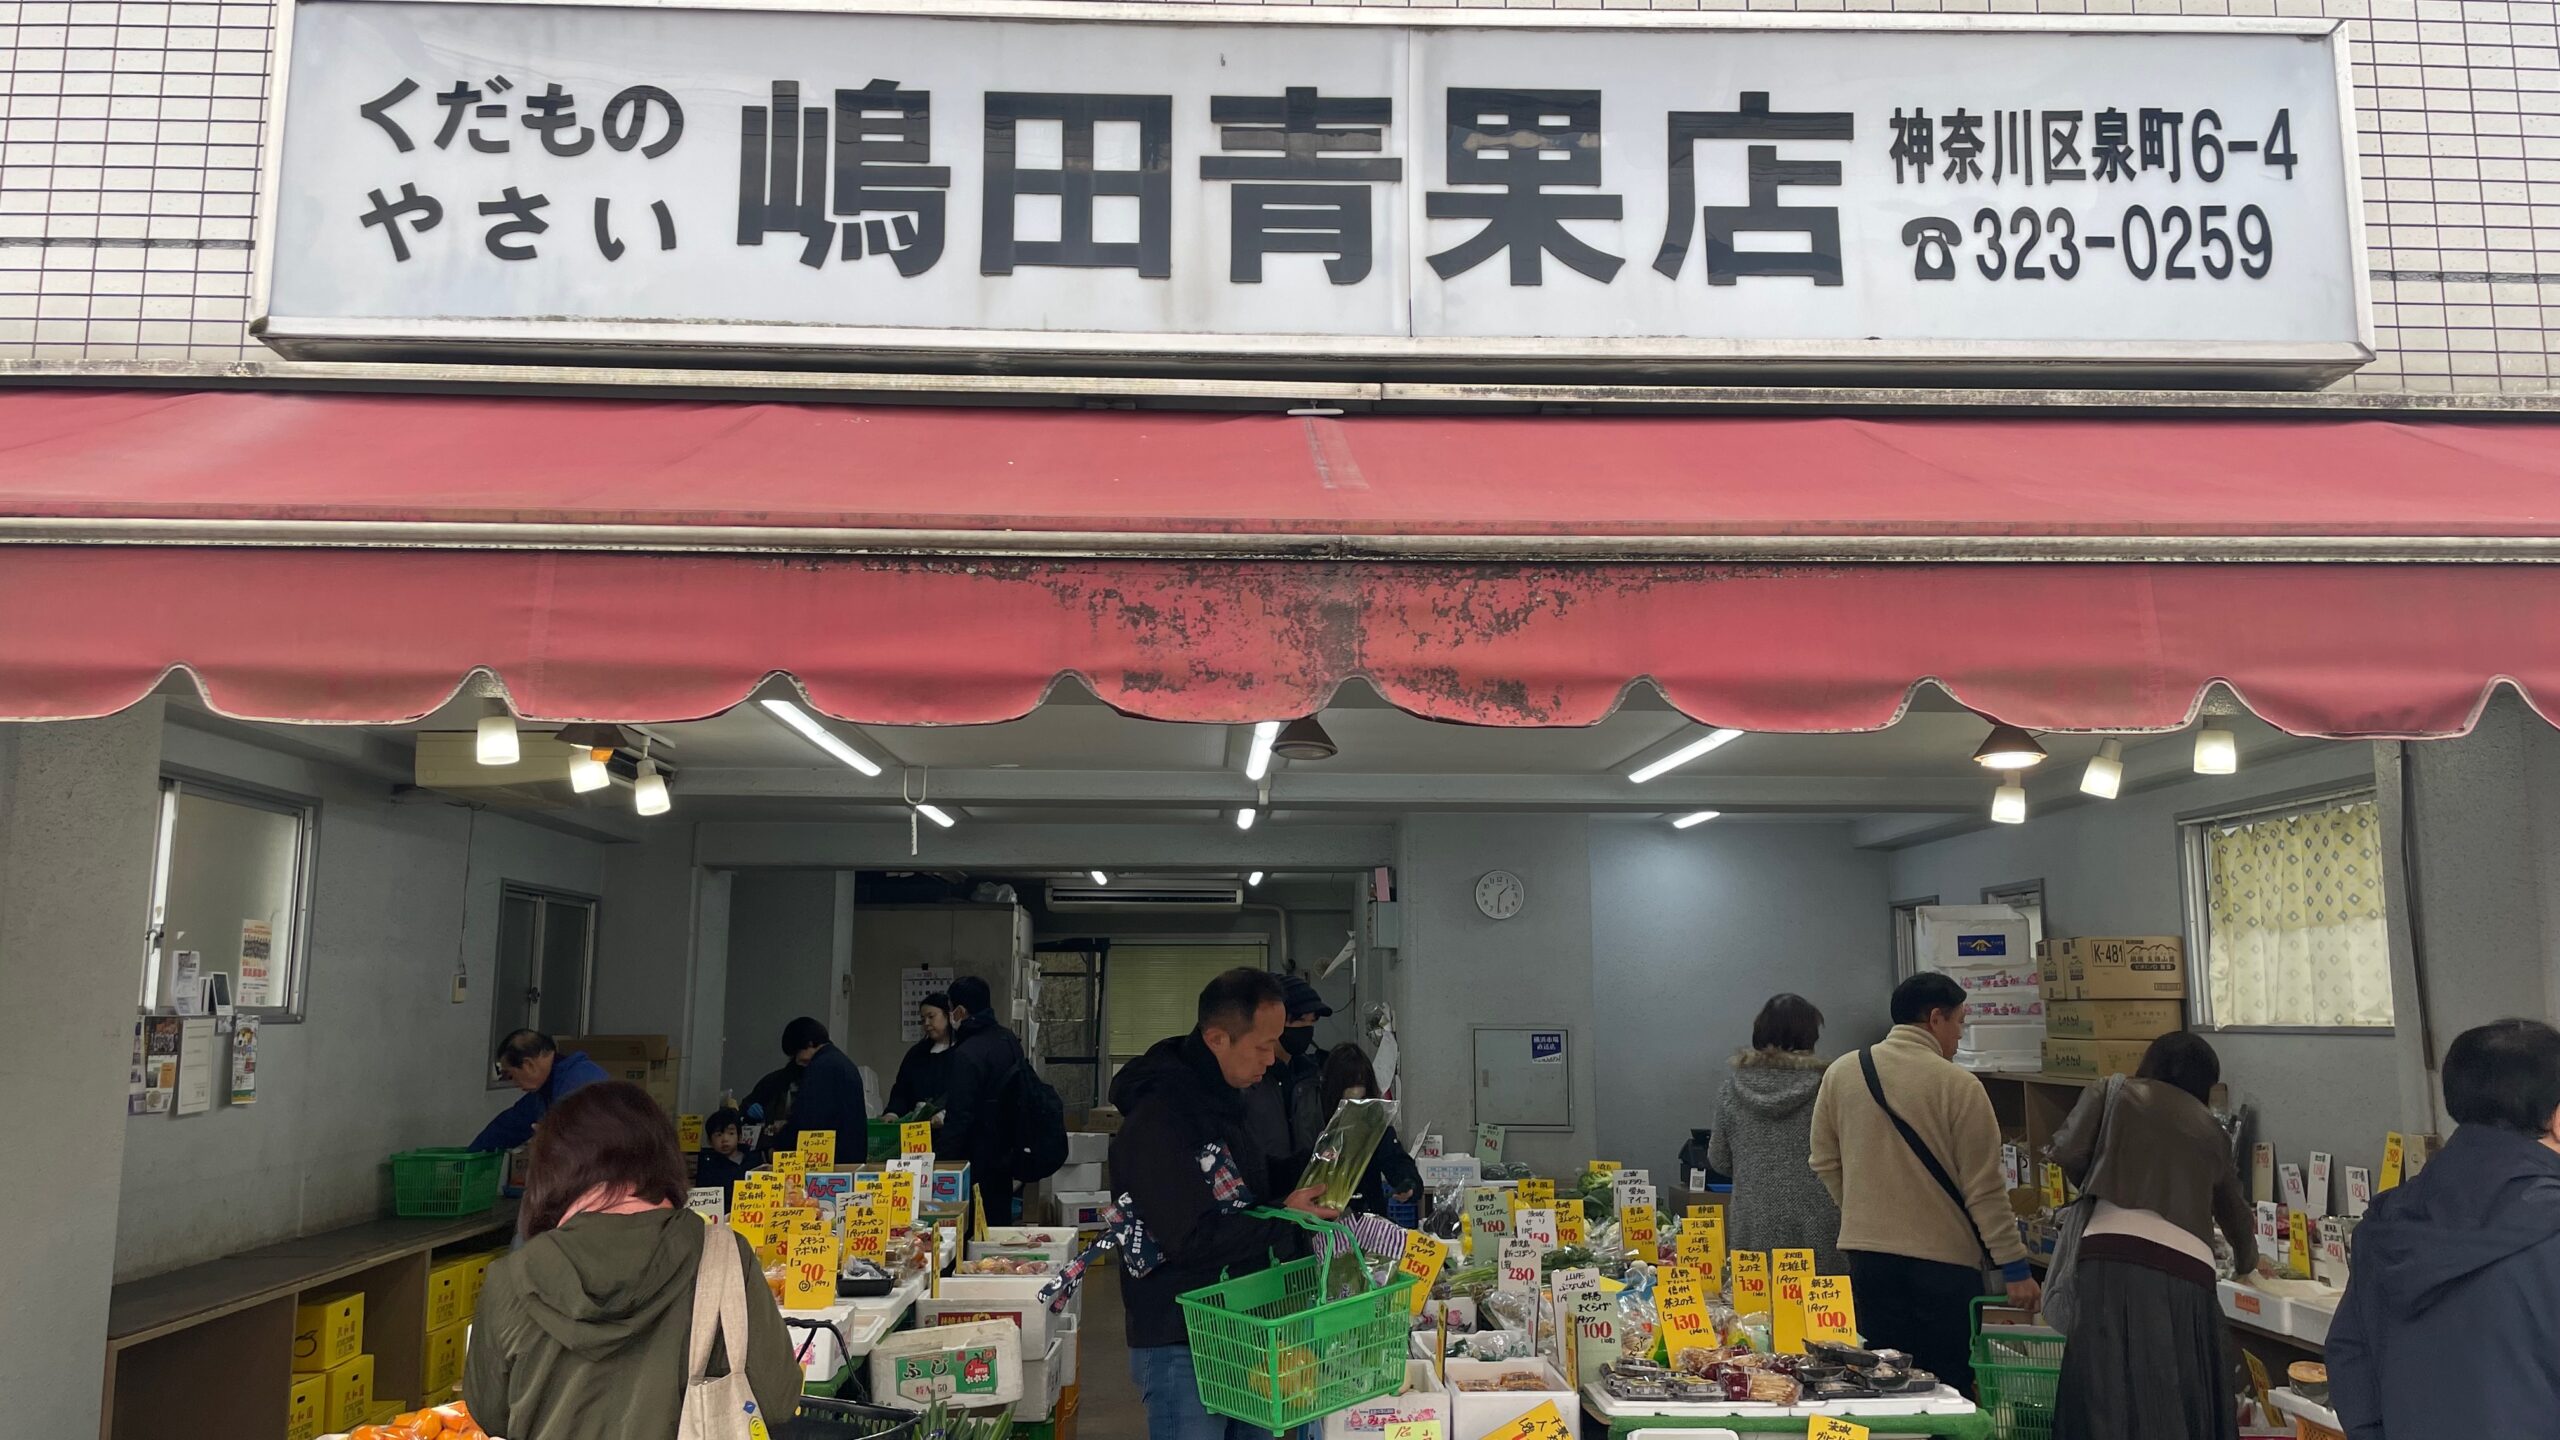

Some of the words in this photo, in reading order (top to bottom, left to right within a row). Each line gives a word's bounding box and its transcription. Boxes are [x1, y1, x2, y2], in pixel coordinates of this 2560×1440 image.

[359, 75, 685, 160] くだもの
[1890, 106, 2298, 187] 神奈川区泉町6-4
[737, 79, 1854, 288] 嶋田青果店
[360, 181, 677, 262] やさい
[1972, 205, 2273, 283] 323-0259
[2093, 943, 2123, 964] K-481
[1627, 1196, 1650, 1204] アイコ
[738, 1211, 763, 1224] 350
[1483, 1219, 1506, 1233] 180
[2260, 1223, 2274, 1237] 120
[799, 1236, 825, 1247] メキシコ
[801, 1263, 825, 1281] 90
[1406, 1259, 1430, 1277] 150
[1508, 1267, 1535, 1281] 280
[1741, 1278, 1764, 1292] 130
[1808, 1288, 1842, 1301] まいたけ
[1673, 1313, 1700, 1331] 130
[1816, 1311, 1847, 1328] 100
[1582, 1320, 1613, 1339] 100
[904, 1359, 949, 1379] ふじ
[937, 1383, 948, 1393] 50
[1827, 1420, 1852, 1436] 茨城
